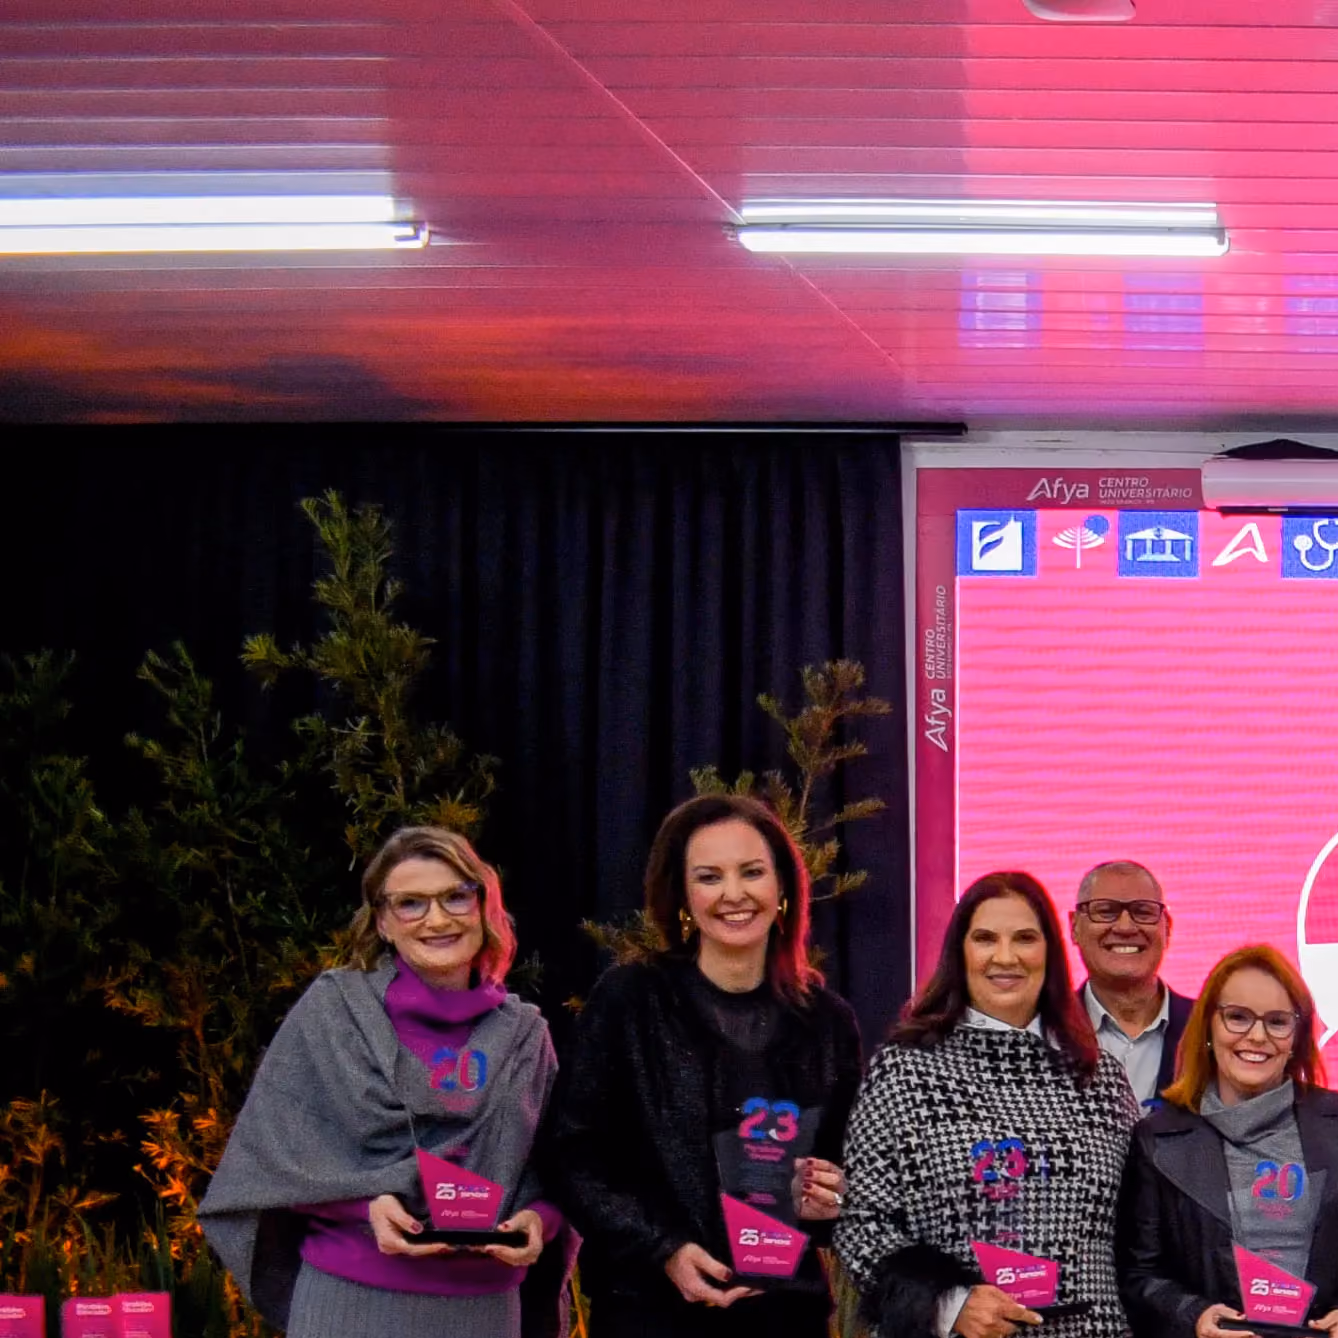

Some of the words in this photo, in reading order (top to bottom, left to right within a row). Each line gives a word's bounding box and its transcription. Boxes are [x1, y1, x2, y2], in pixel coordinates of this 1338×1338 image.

[1026, 477, 1089, 505] Afya
[1098, 477, 1149, 487] CENTRO
[925, 629, 935, 680] CENTRO
[925, 688, 952, 752] Afya
[429, 1047, 488, 1092] 20
[738, 1097, 800, 1141] 23
[1252, 1161, 1305, 1200] 20
